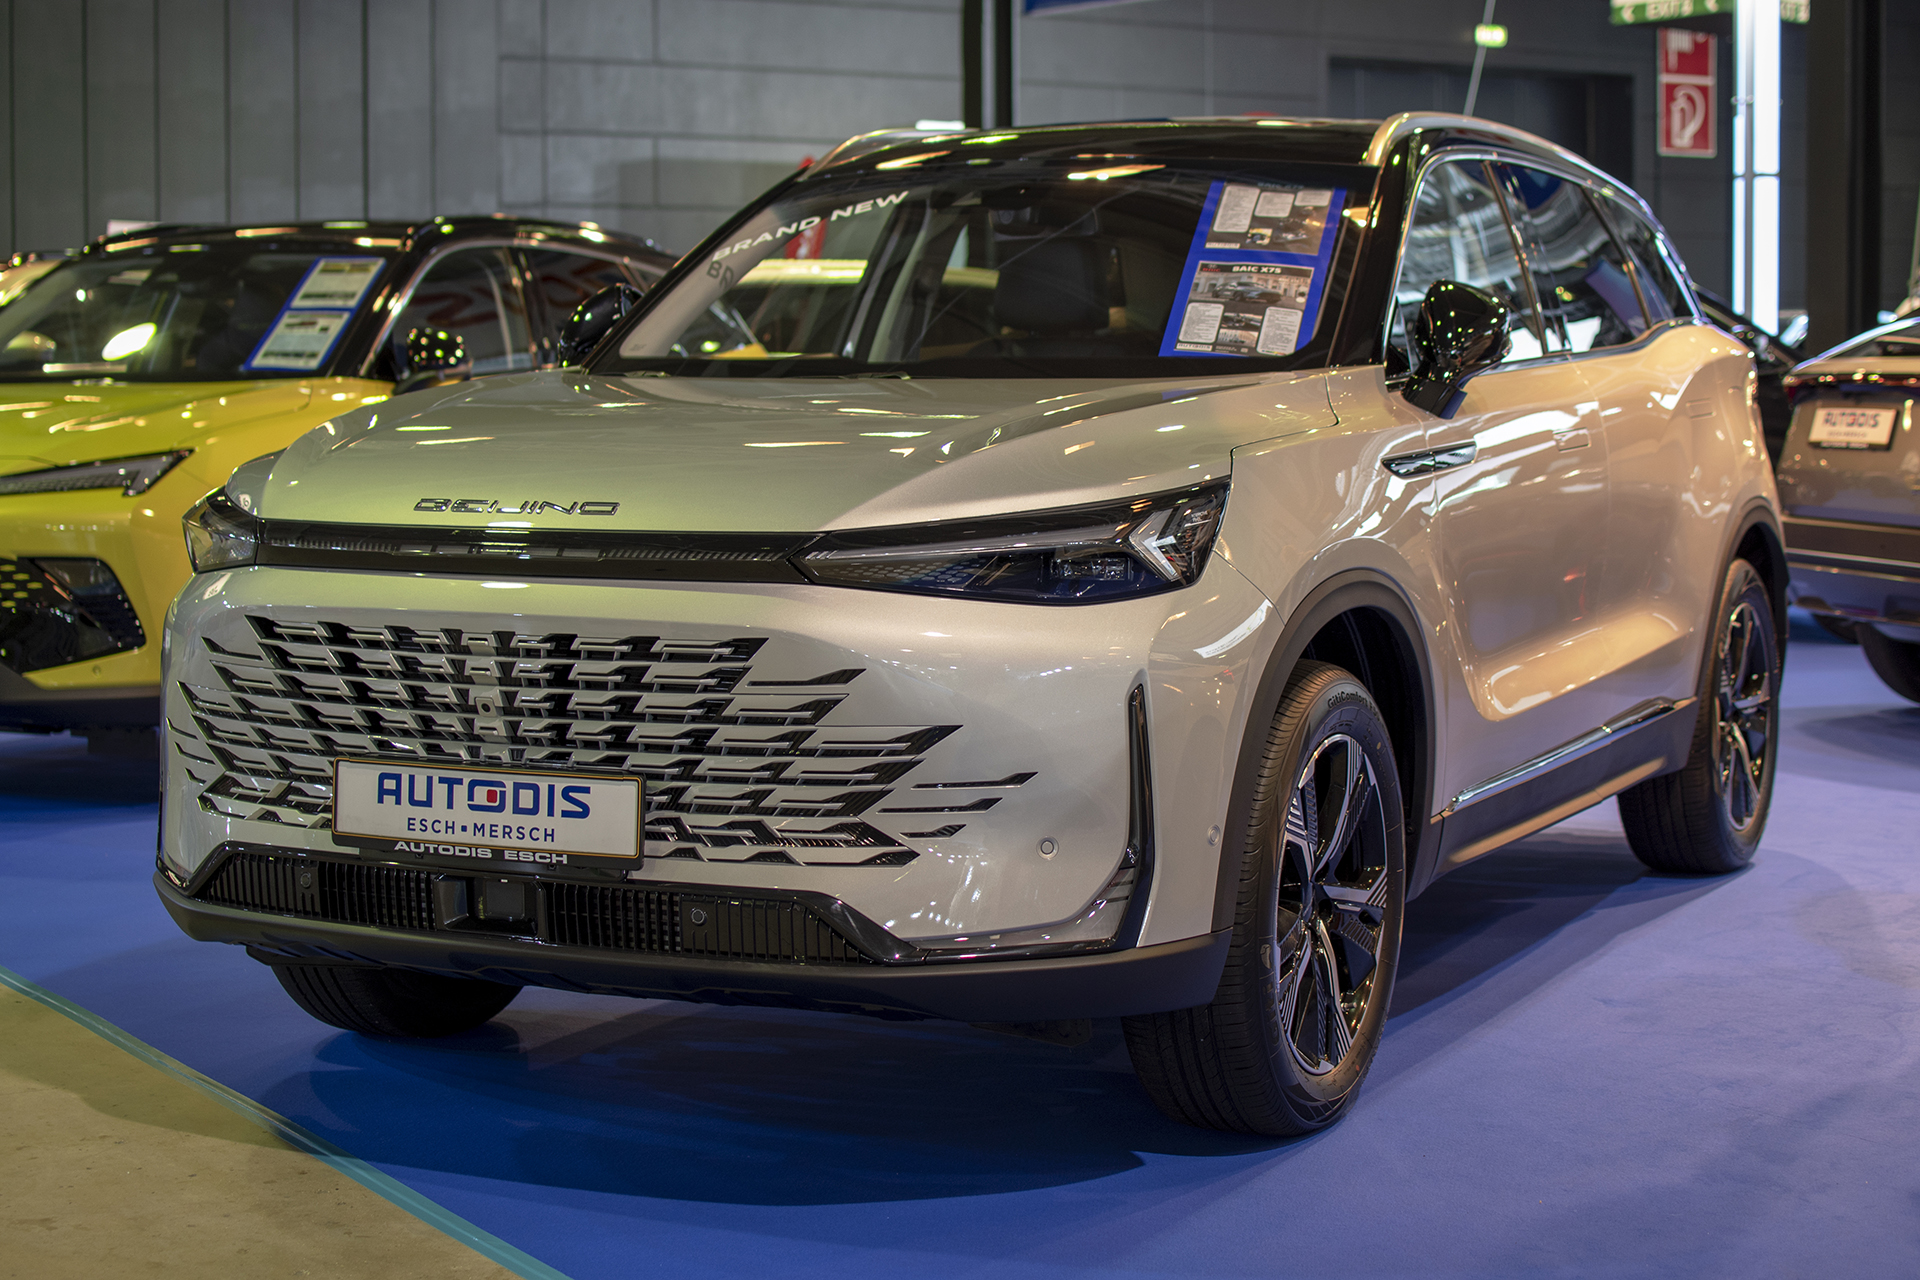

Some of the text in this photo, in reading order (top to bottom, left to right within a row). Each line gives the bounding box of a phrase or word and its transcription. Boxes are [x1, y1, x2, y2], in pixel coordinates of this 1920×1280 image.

[712, 190, 909, 261] BRAND NEW
[1232, 265, 1259, 273] BAIC
[1823, 412, 1881, 428] AUTODIS
[414, 498, 620, 515] BEIJING
[377, 772, 591, 819] AUTODIS
[394, 841, 568, 864] AUTODIS ESCH
